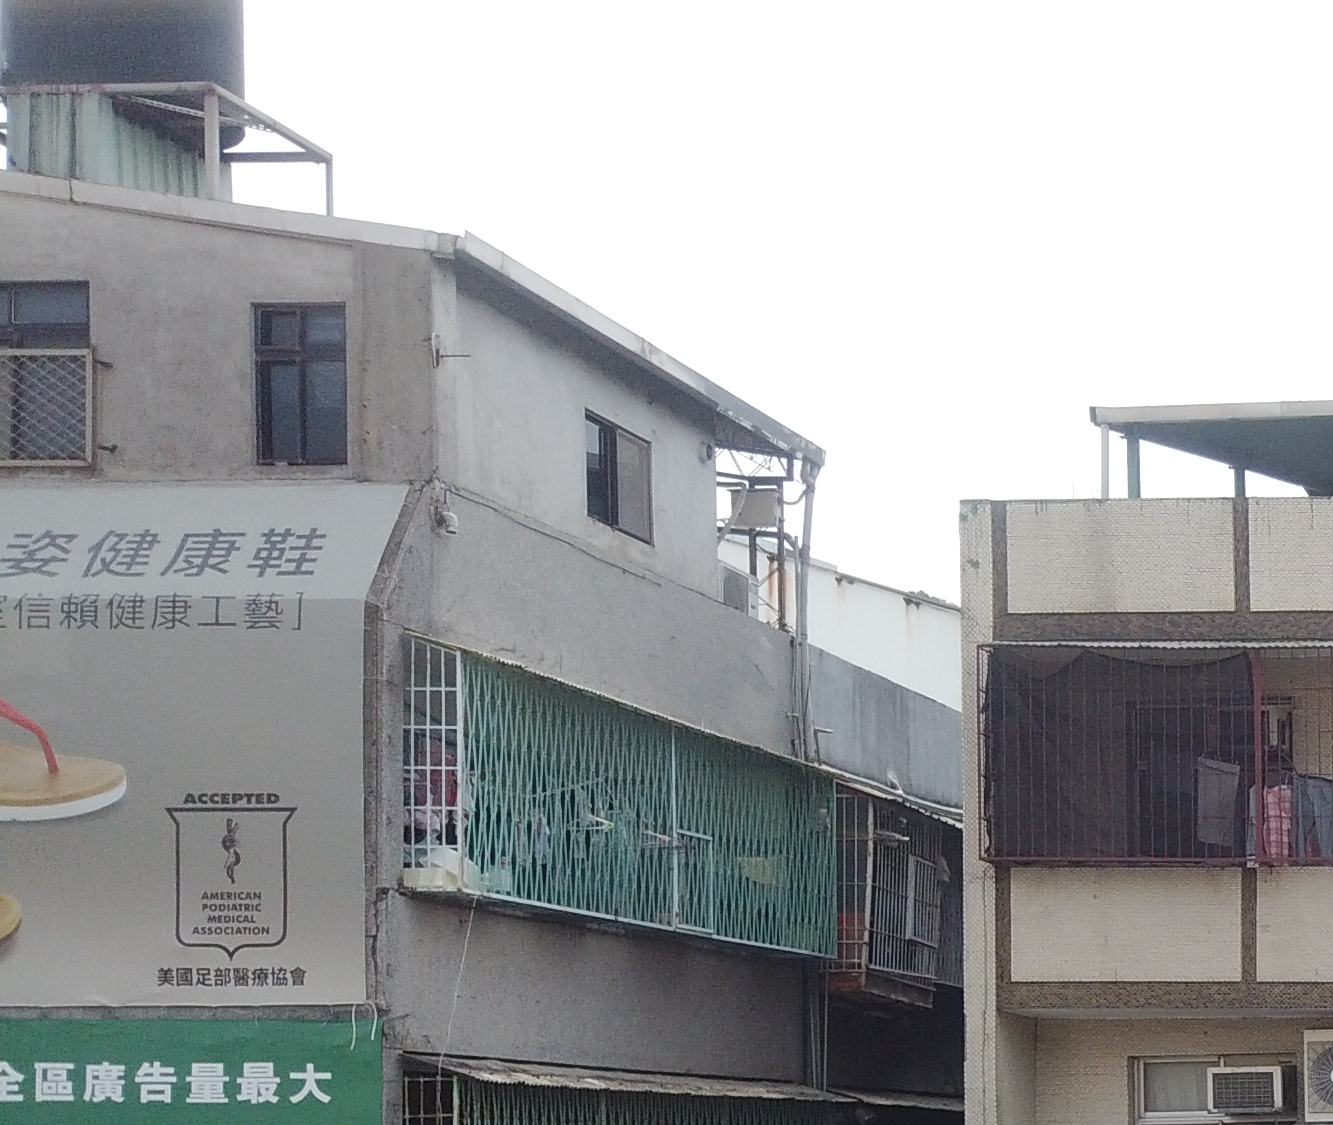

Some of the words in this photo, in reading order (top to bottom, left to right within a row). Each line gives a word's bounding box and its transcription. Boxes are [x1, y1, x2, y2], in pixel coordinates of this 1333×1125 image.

[0, 591, 305, 630] 信賴健康工藝]
[183, 793, 280, 804] ACCEPTED
[201, 891, 262, 900] AMERICAN
[201, 903, 262, 912] PODIATRIC
[207, 915, 256, 924] MEDICAL
[192, 926, 270, 935] ASSOCIATION
[157, 967, 307, 987] 美國足部醫療協會
[0, 1061, 333, 1105] 全區廣告量最大
